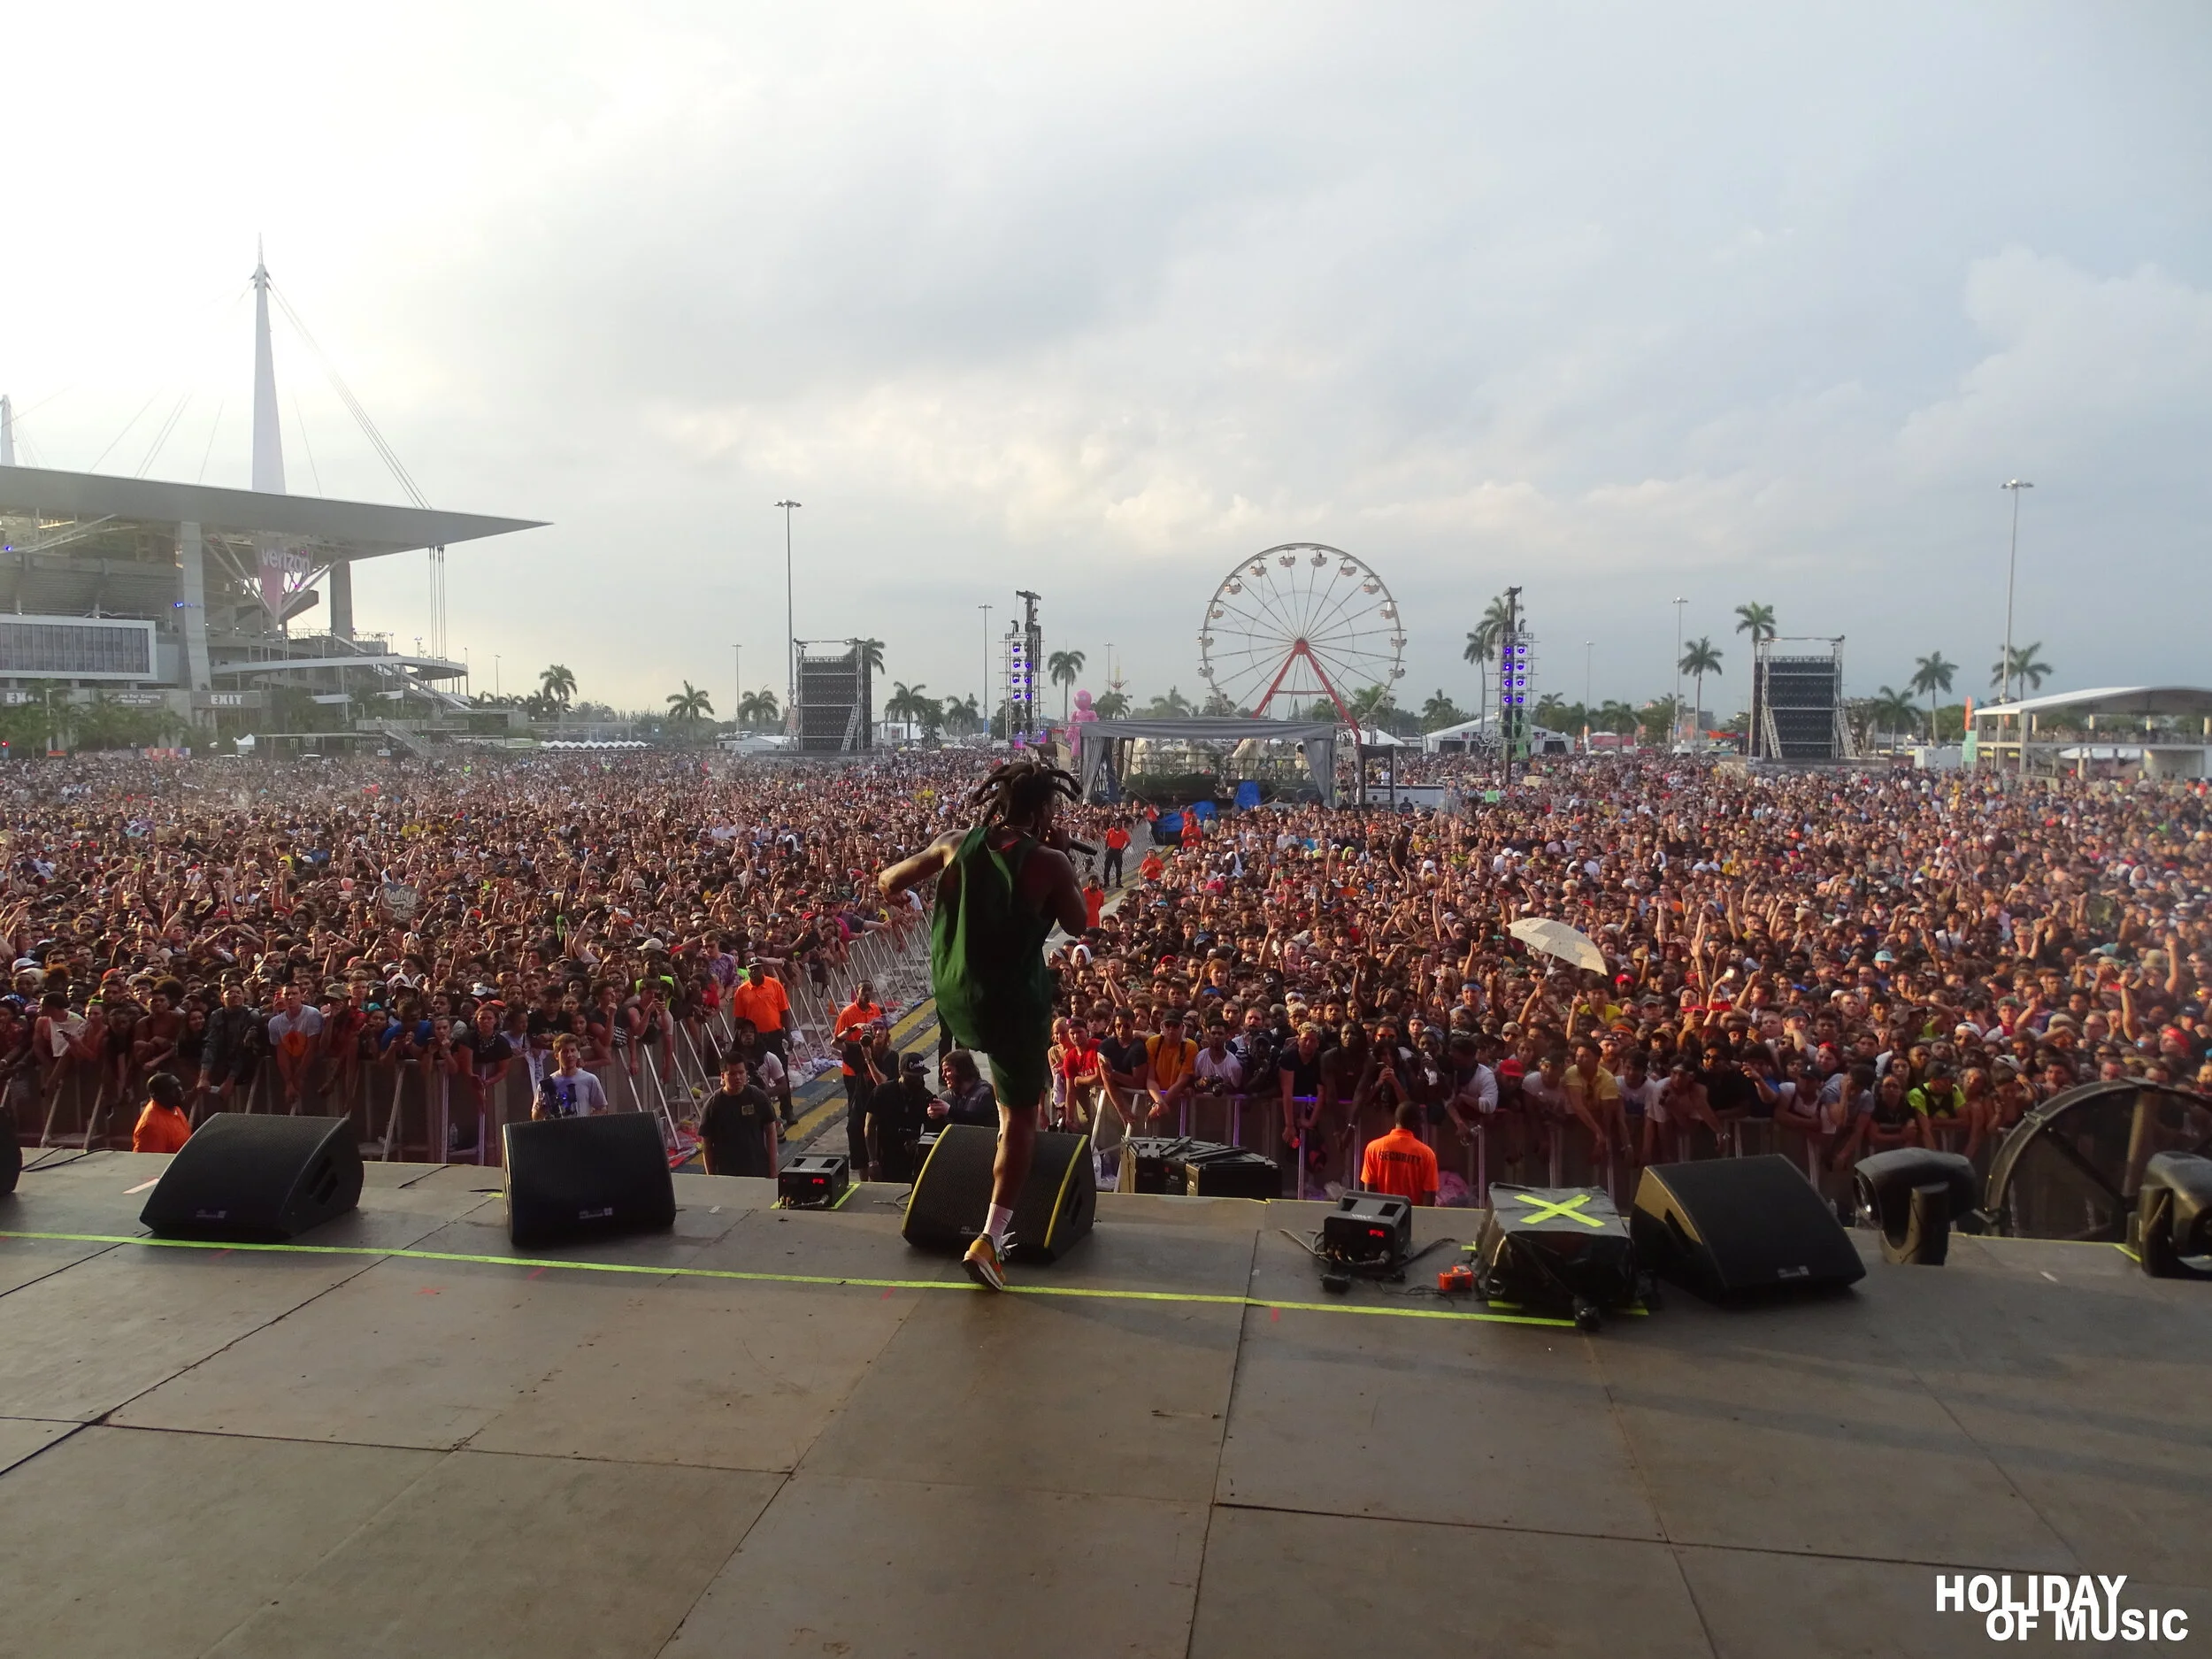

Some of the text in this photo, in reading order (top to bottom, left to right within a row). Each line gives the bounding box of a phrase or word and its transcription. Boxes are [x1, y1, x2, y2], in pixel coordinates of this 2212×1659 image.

[262, 549, 311, 576] verizon
[211, 695, 242, 705] EXIT
[384, 887, 417, 908] Rolling
[1379, 1150, 1422, 1164] SECURITY
